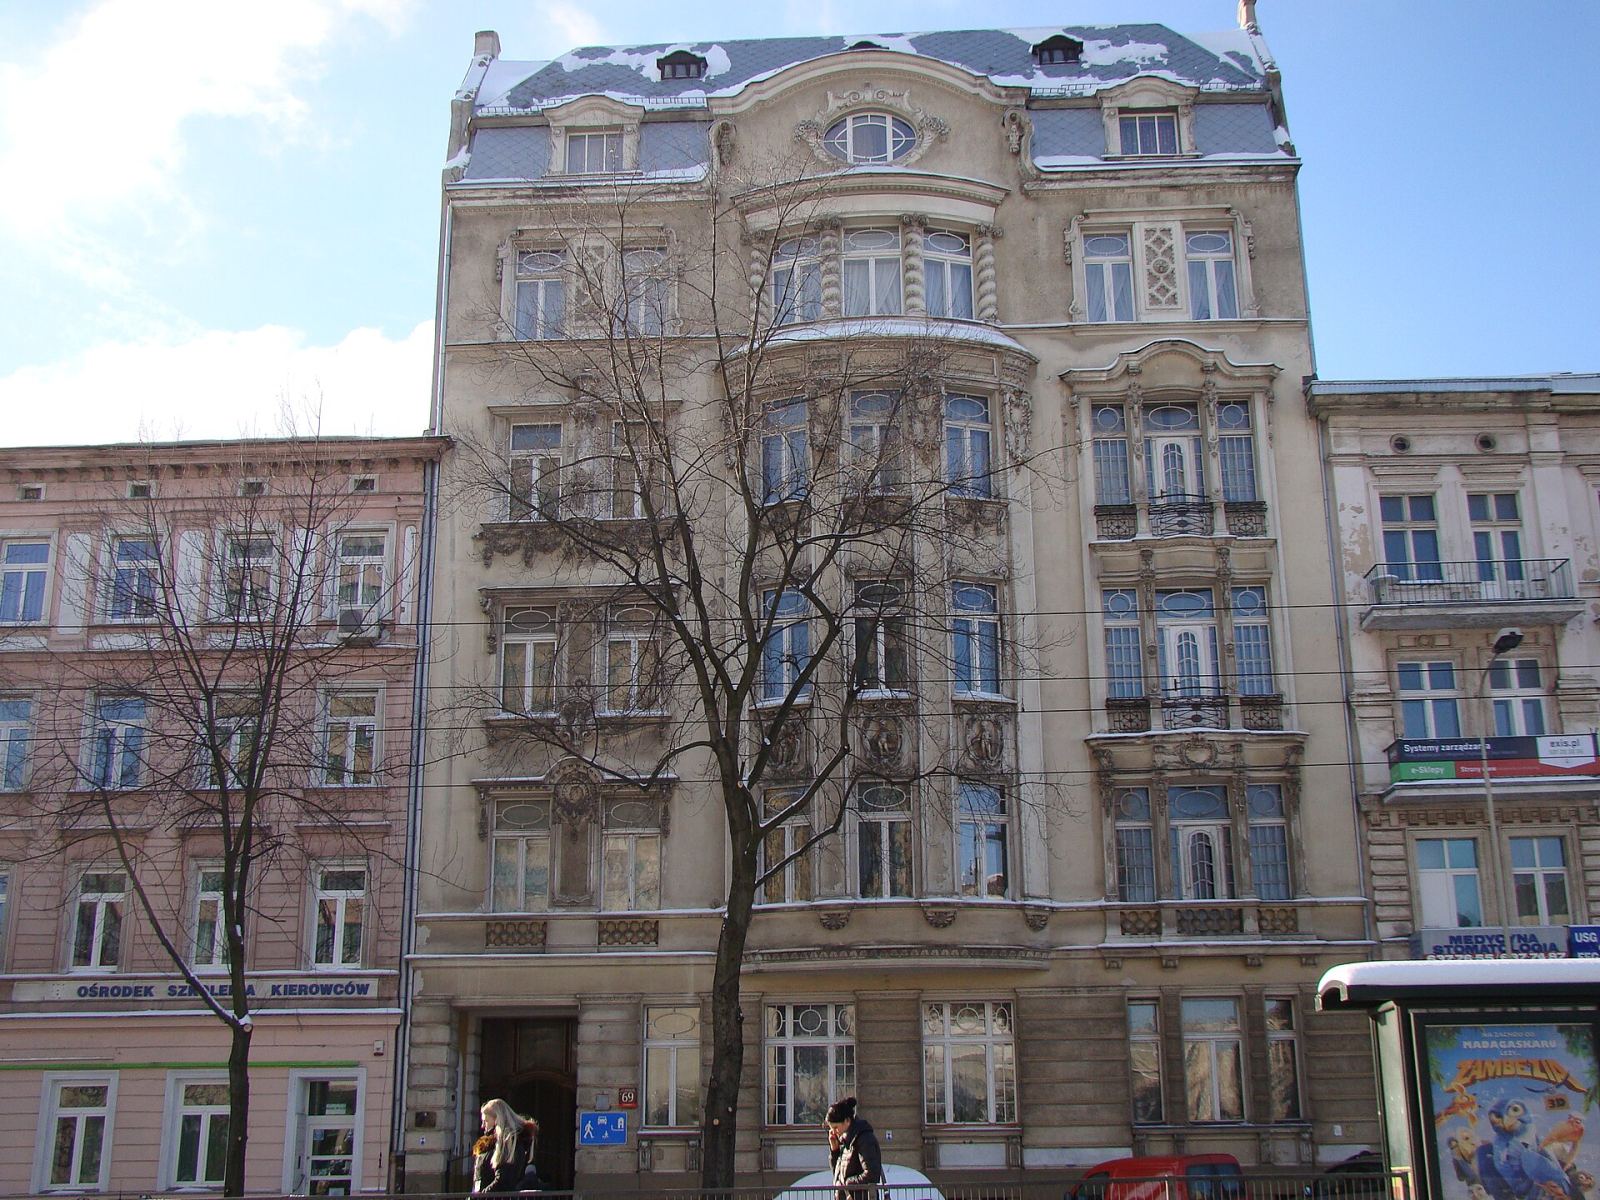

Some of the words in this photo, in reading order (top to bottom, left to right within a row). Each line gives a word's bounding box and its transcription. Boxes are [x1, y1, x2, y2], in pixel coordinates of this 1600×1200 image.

[1403, 744, 1439, 753] Systemy
[1440, 742, 1491, 752] zarządzana
[1550, 738, 1580, 748] exis.pl
[1411, 766, 1445, 775] e-Sklepy
[1574, 932, 1598, 943] USG
[76, 982, 155, 998] OŚRODEK
[167, 984, 256, 997] SZKLEA
[271, 981, 370, 996] KIEROWCÓW
[1463, 1040, 1557, 1049] MADAGASKARU
[622, 1091, 634, 1103] 69
[1546, 1097, 1566, 1109] 3D
